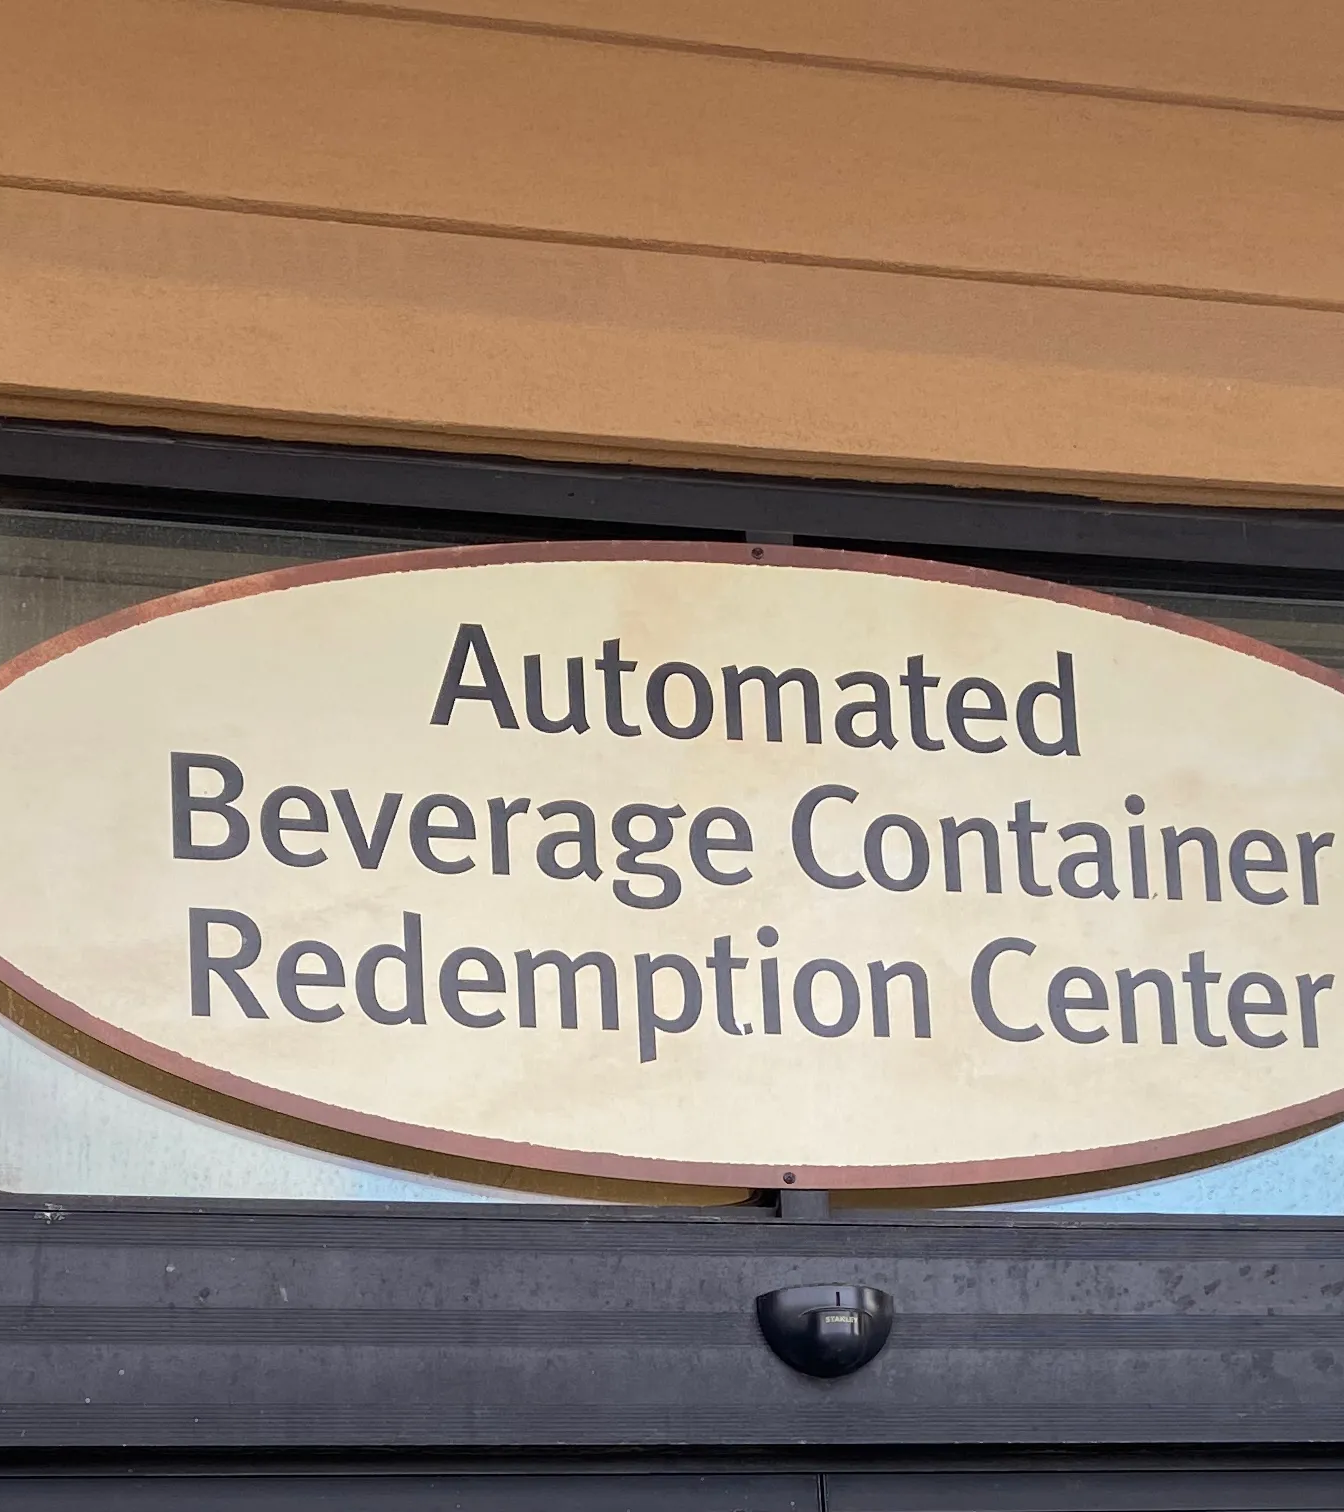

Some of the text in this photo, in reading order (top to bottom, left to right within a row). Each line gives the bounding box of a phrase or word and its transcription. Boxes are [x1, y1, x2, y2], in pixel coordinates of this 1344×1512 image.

[430, 624, 1081, 756] Automated
[170, 752, 1335, 910] Beverage Container
[188, 907, 1335, 1062] Redemption Center
[825, 1315, 858, 1323] STANLEY
